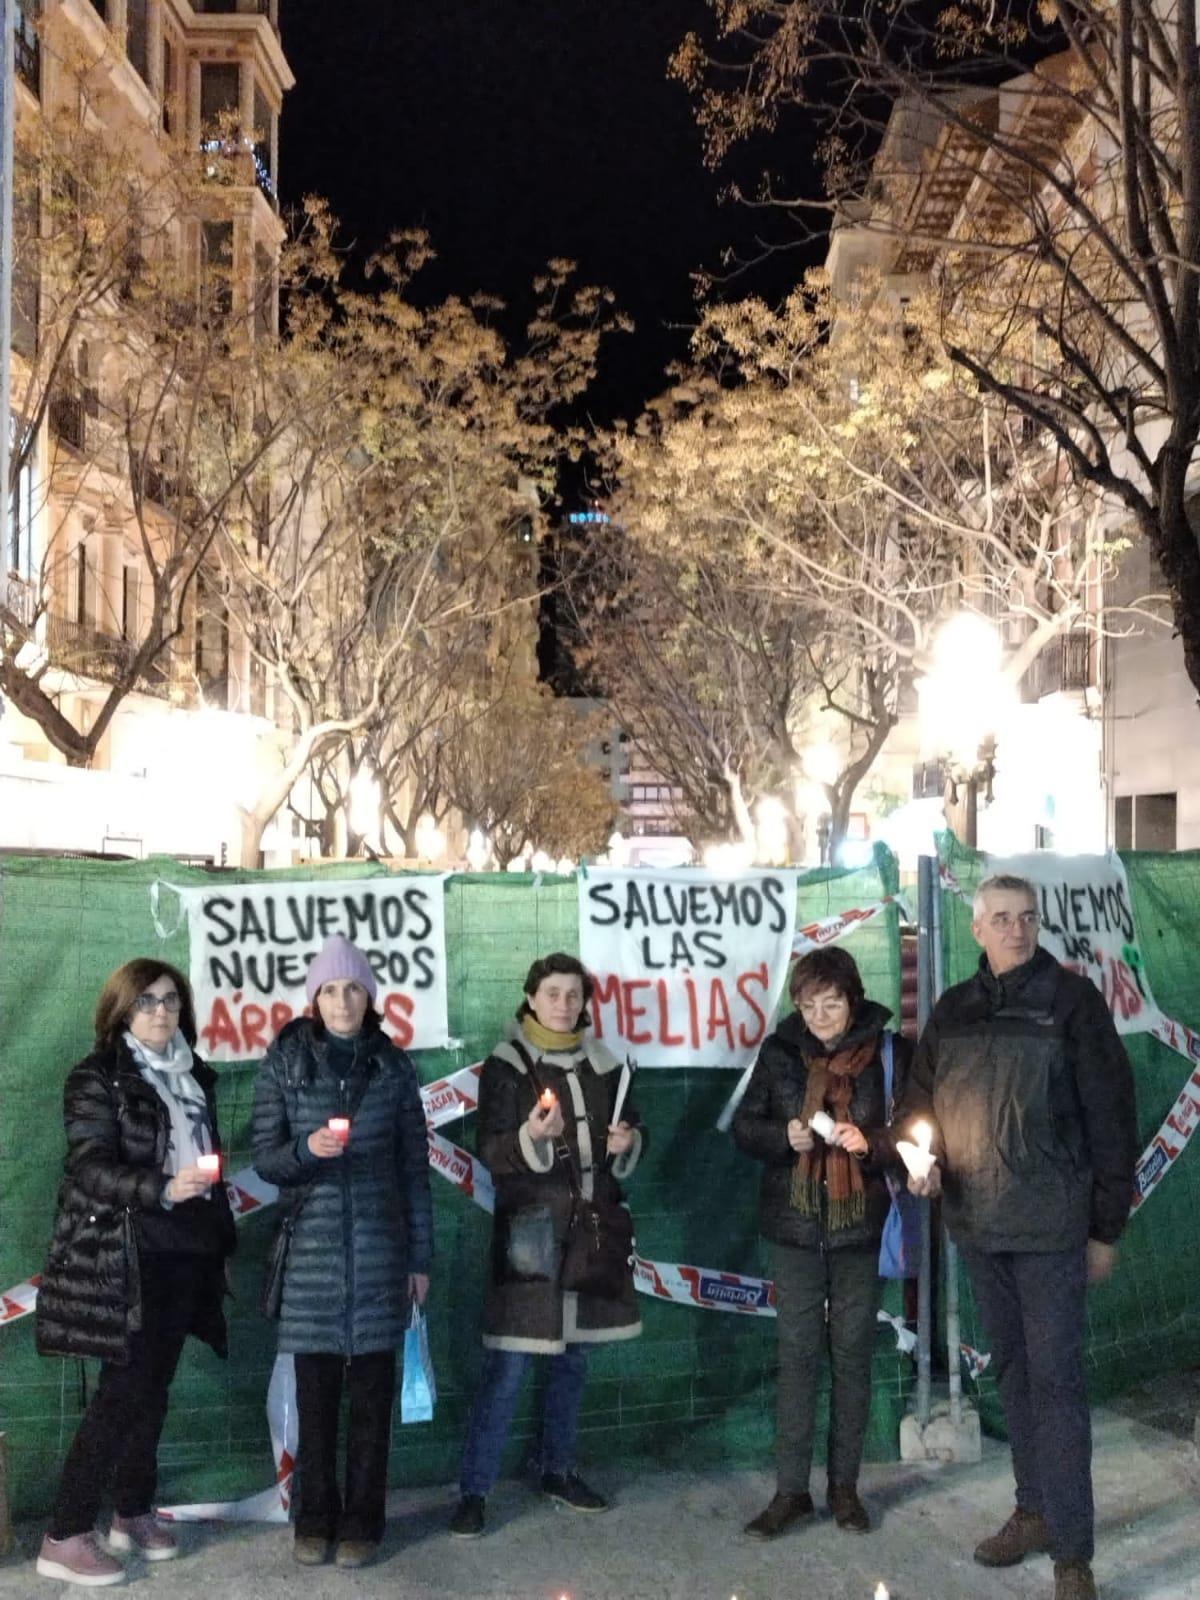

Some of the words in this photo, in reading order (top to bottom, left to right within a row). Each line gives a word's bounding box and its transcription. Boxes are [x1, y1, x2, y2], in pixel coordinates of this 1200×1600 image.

[202, 888, 433, 946] SALVEMOS
[588, 876, 787, 933] SALVEMOS
[1040, 880, 1135, 944] LVEMOS
[209, 946, 435, 994] NUEROS
[642, 930, 728, 969] LAS
[1062, 936, 1095, 965] LAS
